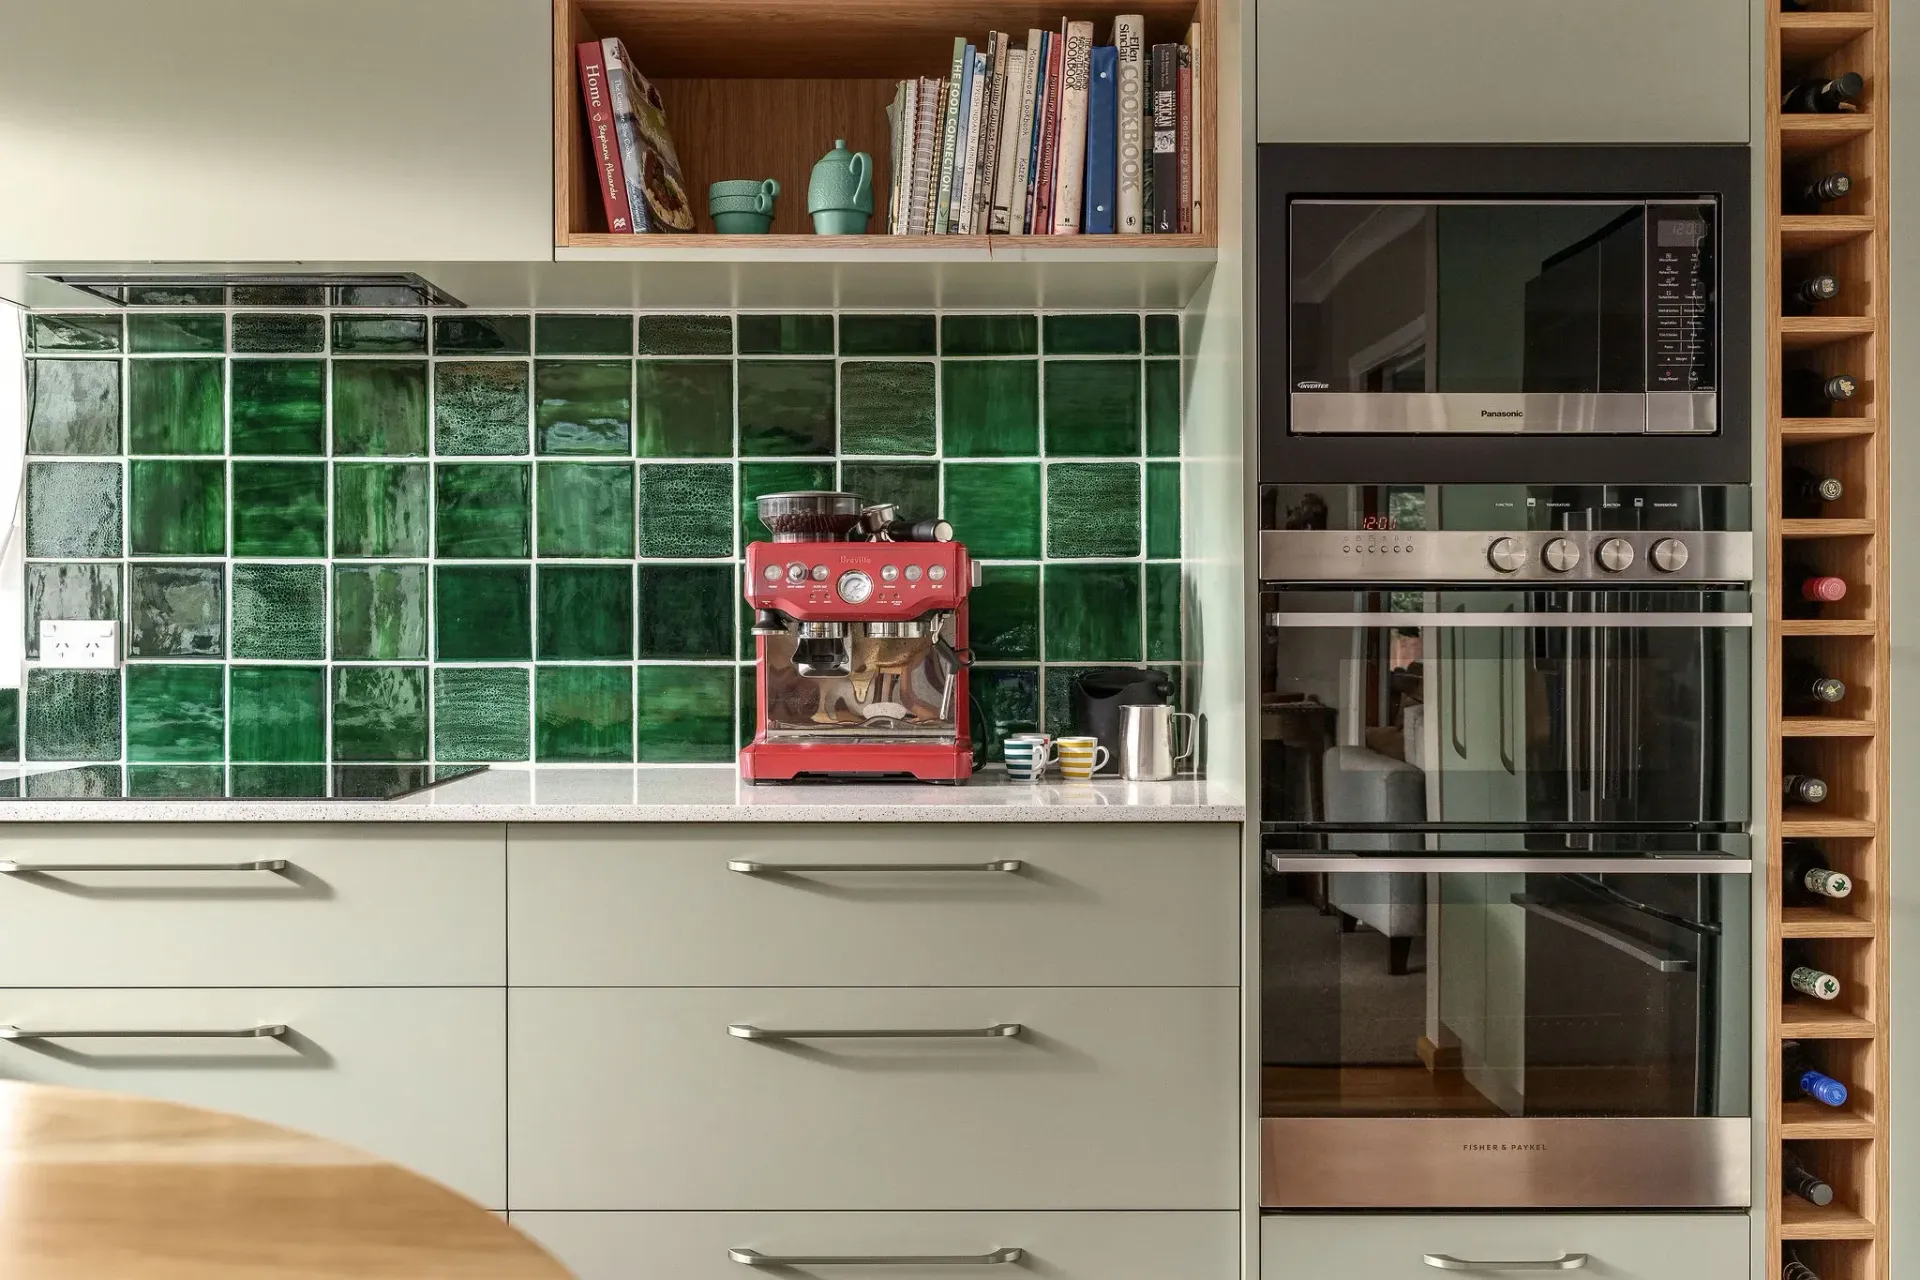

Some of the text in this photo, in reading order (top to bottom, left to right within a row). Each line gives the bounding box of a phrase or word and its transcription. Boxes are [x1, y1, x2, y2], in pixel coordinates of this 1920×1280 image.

[1065, 36, 1078, 90] COOKBOOK
[1130, 36, 1140, 62] Ellen
[991, 72, 1002, 106] Popular
[1048, 74, 1058, 108] Popular
[942, 58, 964, 192] THE FOOD CONNECTION
[988, 108, 998, 142] Chinese
[1018, 48, 1037, 182] Moosewood Cookbook Katzen
[1120, 24, 1140, 193] Sinclair COOKBOOK
[1158, 90, 1172, 126] MEXICAN
[586, 64, 618, 200] Home Stephanie Alexander
[967, 80, 982, 176] STYLISH INDIAN IN MINUTES
[1180, 116, 1189, 152] cooking
[1182, 153, 1188, 165] up
[1481, 410, 1524, 418] Panasonic
[840, 556, 871, 564] Breville
